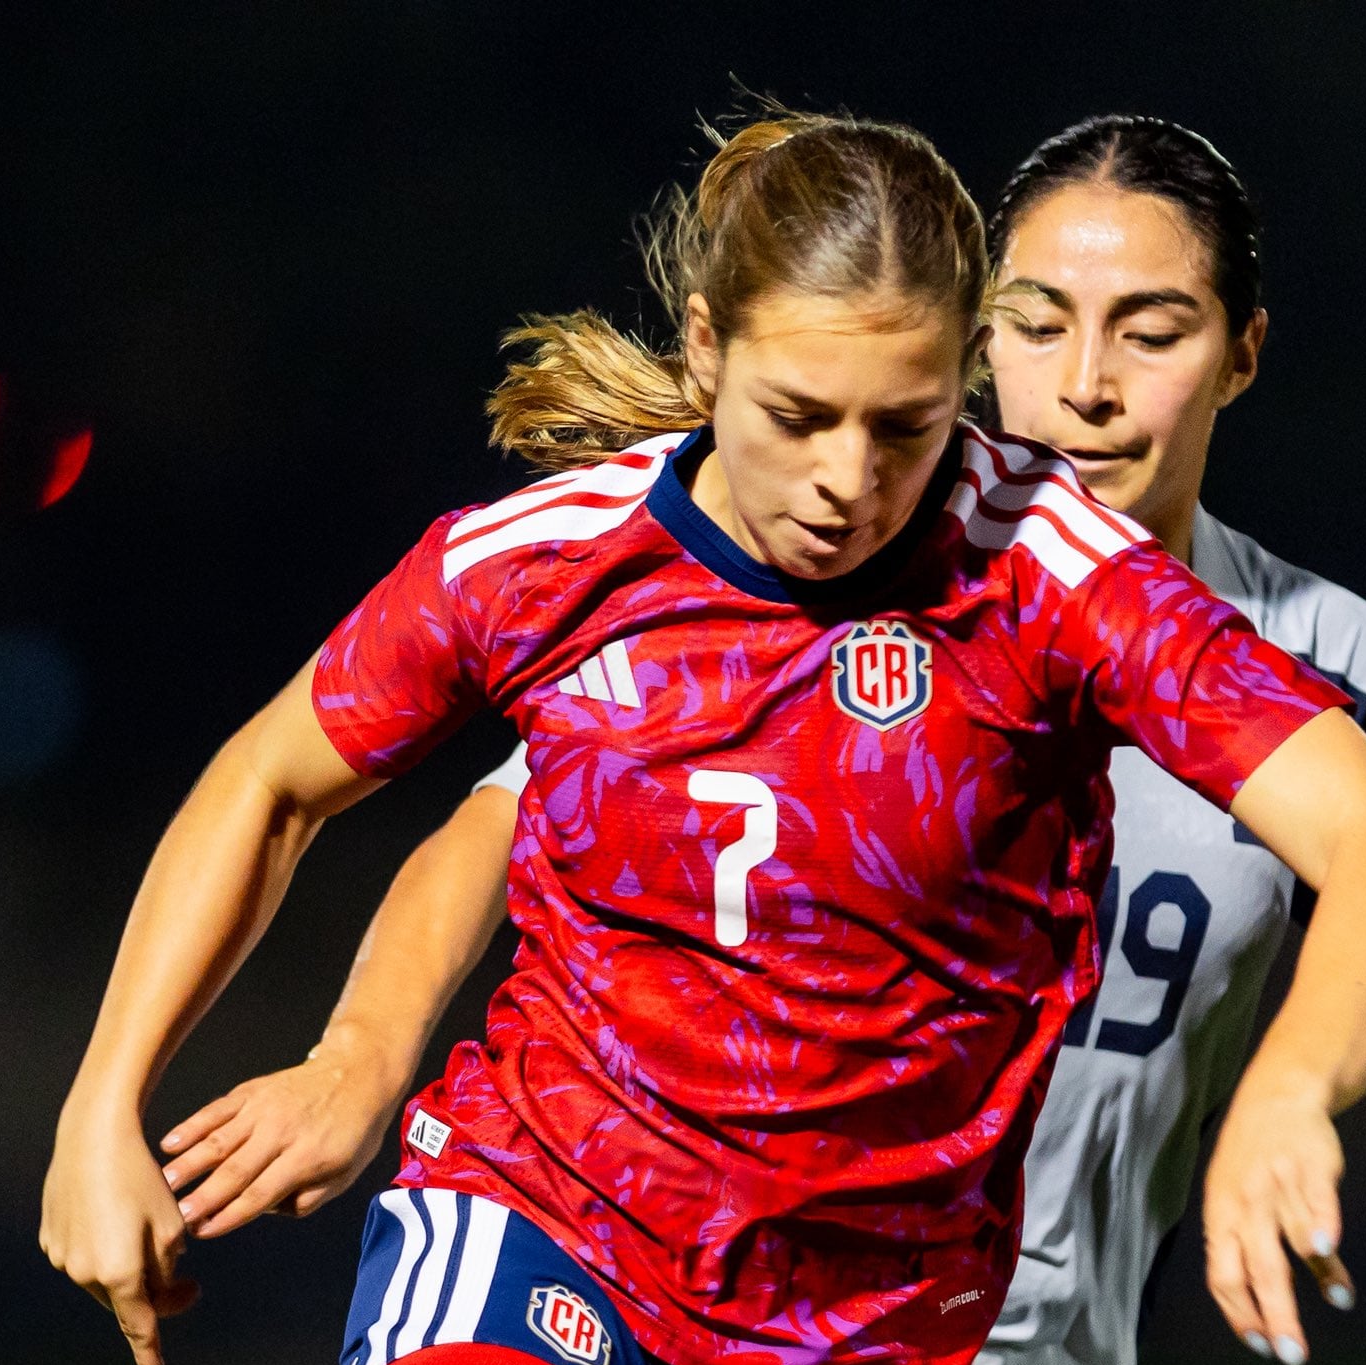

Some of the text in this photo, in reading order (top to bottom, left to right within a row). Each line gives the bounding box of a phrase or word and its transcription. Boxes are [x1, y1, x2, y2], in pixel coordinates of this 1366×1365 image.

[856, 643, 908, 709] CR
[687, 769, 778, 947] 7
[549, 1298, 596, 1354] CR
